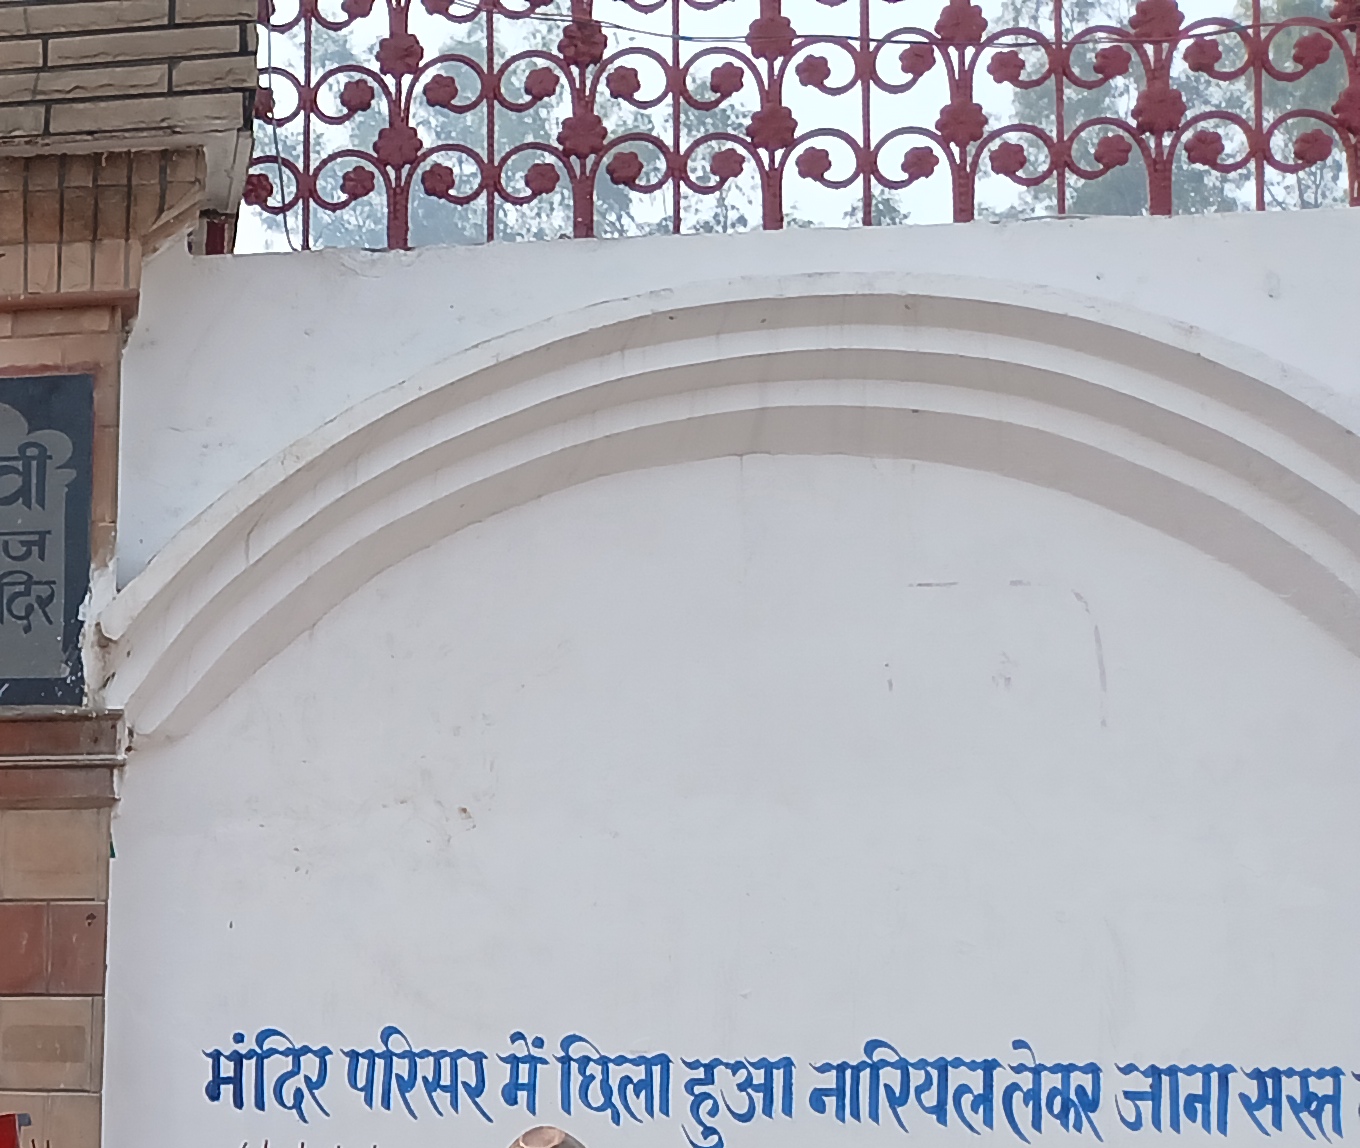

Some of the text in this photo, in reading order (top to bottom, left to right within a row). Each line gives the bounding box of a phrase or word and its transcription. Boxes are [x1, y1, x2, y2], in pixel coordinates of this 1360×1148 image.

[202, 1027, 333, 1124] मंदिर
[340, 1025, 494, 1123] परिसर
[496, 1030, 550, 1115] में
[808, 1038, 1005, 1135] नारियल
[1115, 1061, 1238, 1137] जाना
